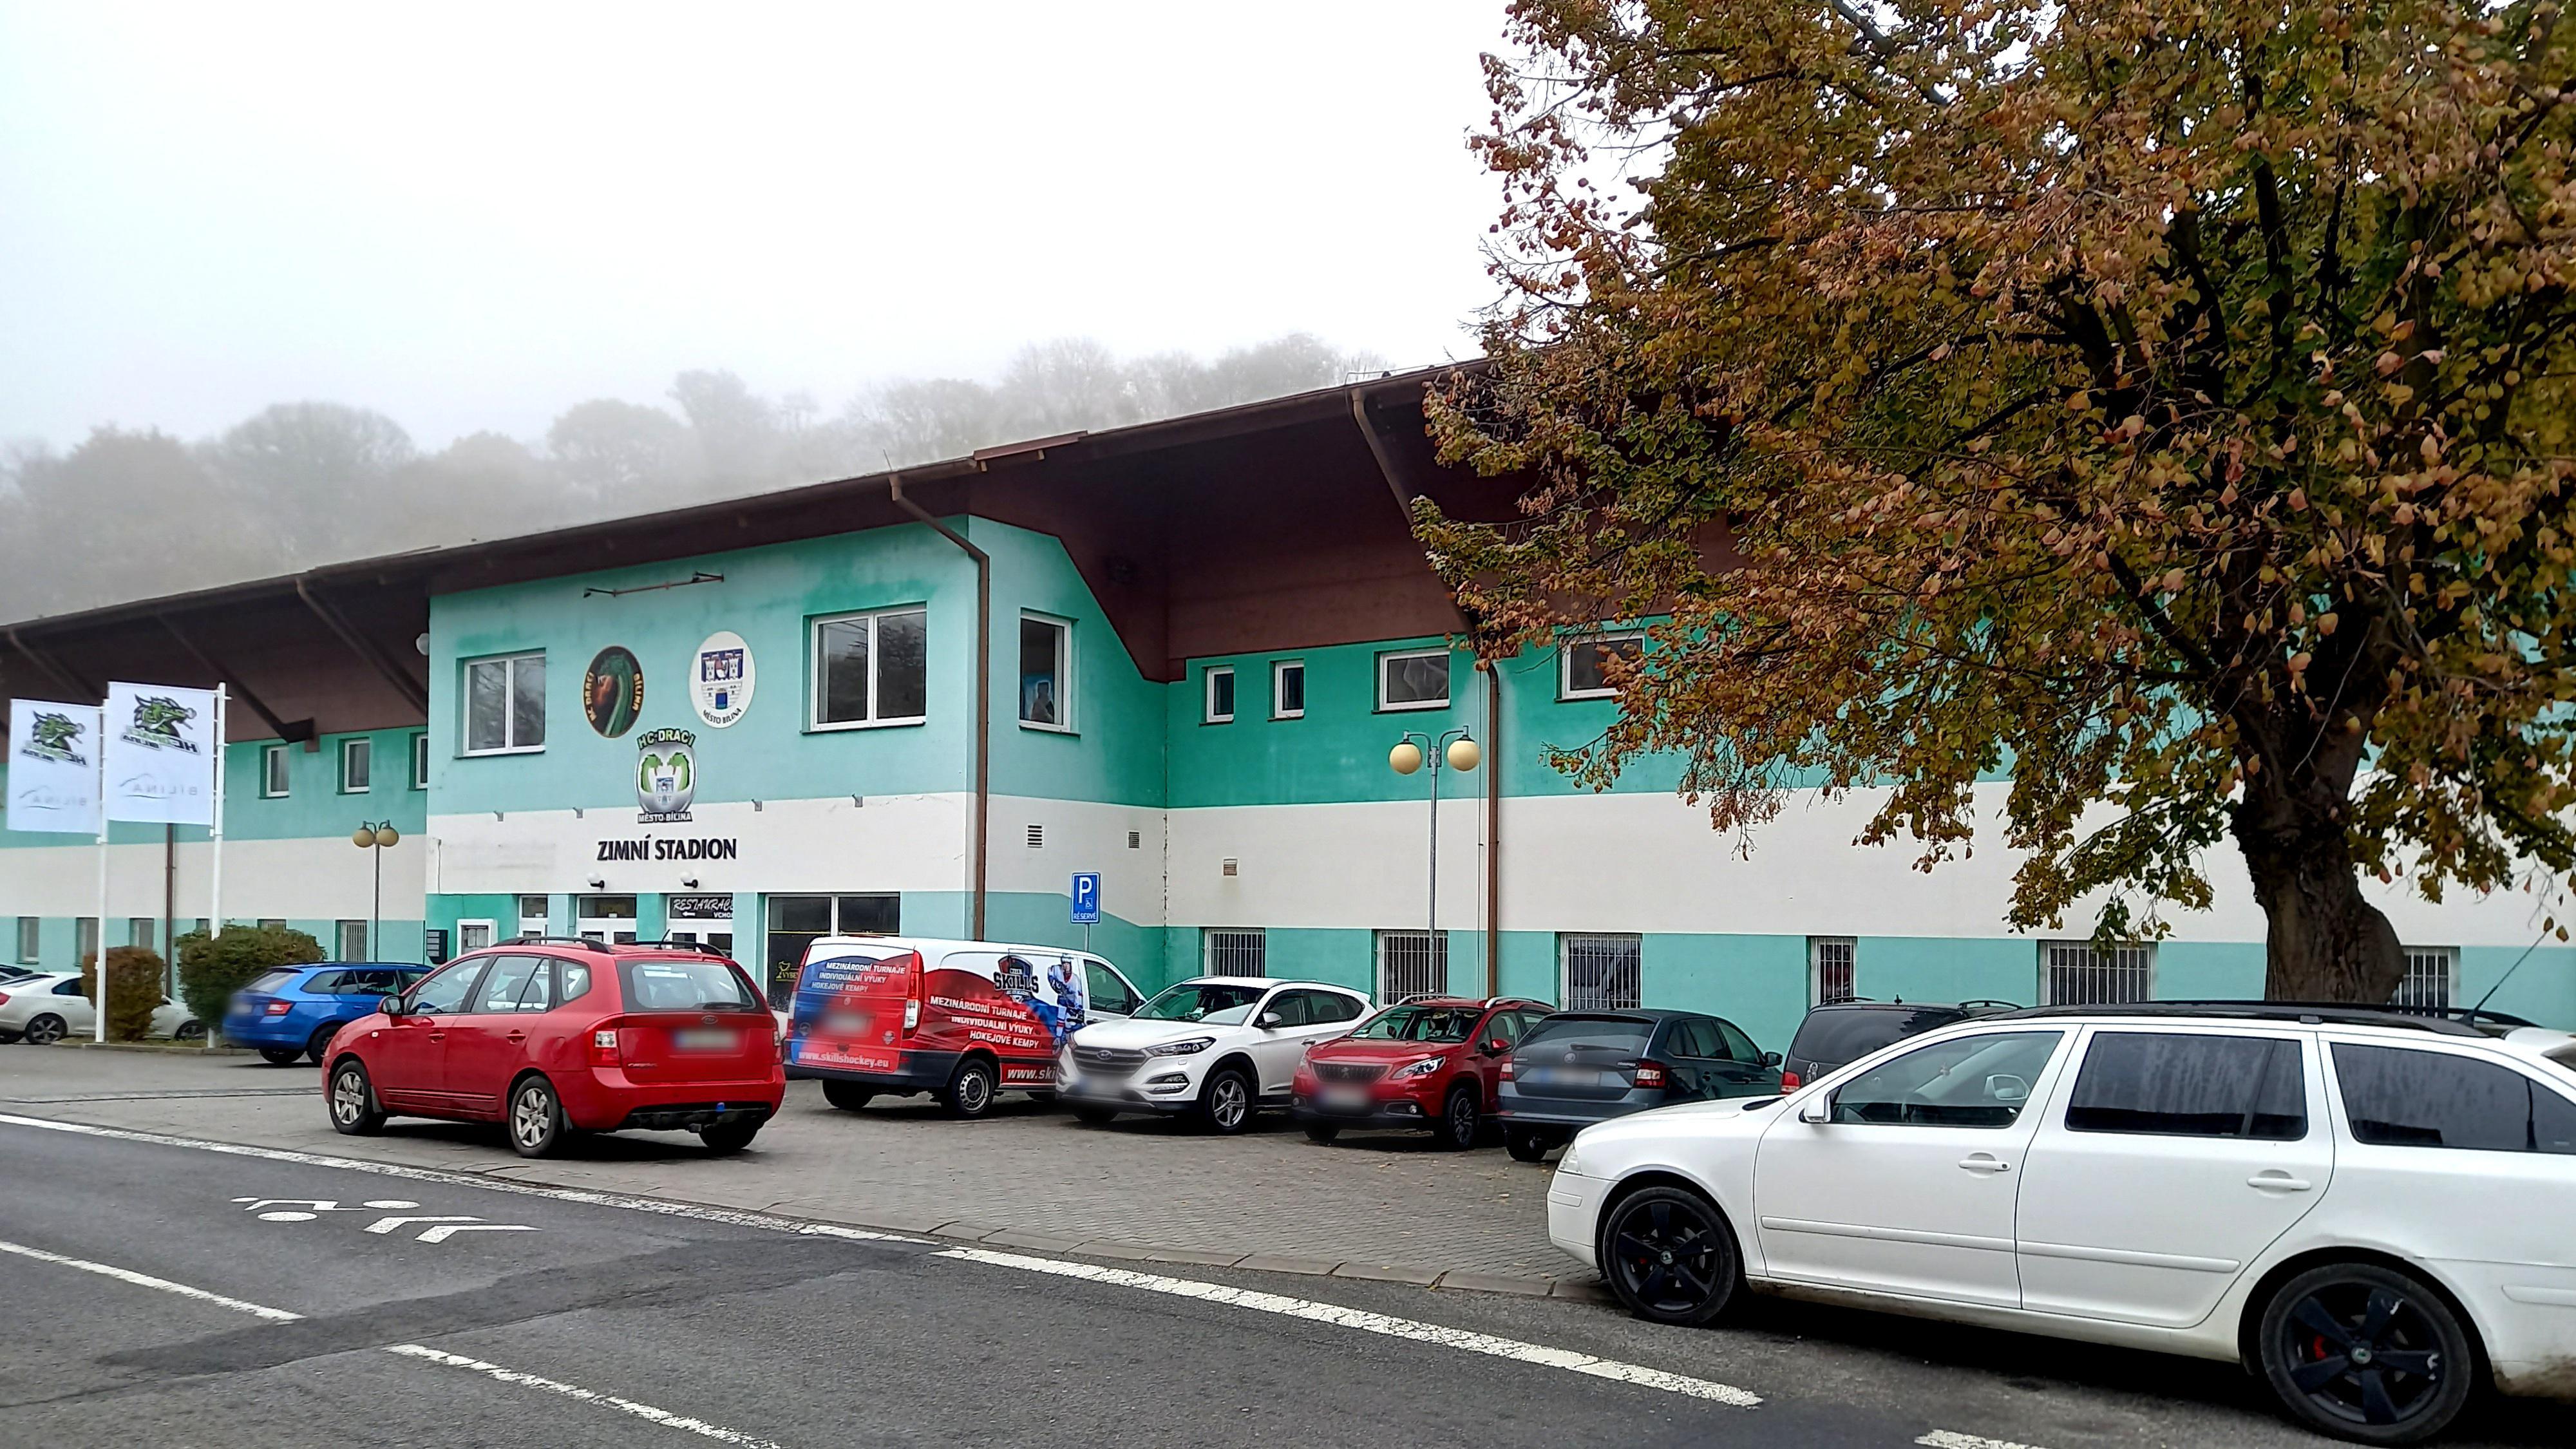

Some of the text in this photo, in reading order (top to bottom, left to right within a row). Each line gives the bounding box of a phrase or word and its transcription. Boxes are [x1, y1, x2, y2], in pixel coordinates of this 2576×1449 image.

[596, 833, 737, 861] ZIMNÍ STADION
[1078, 876, 1092, 904] P
[819, 972, 863, 982] INDIVIDUÁLNÍ
[826, 961, 906, 974] MEZINÁRODNÍ TURNAJE
[811, 981, 869, 992] HOKEJOVÉ KEMPY
[993, 971, 1039, 994] SKILLS
[929, 995, 1028, 1021] MEZINÁRODNÍ TURNAJE
[1008, 1021, 1034, 1036] VÝUKY
[969, 1029, 1039, 1050] HOKEJOVÉ KEMPY
[798, 1050, 889, 1068] www.skillshockey.eu
